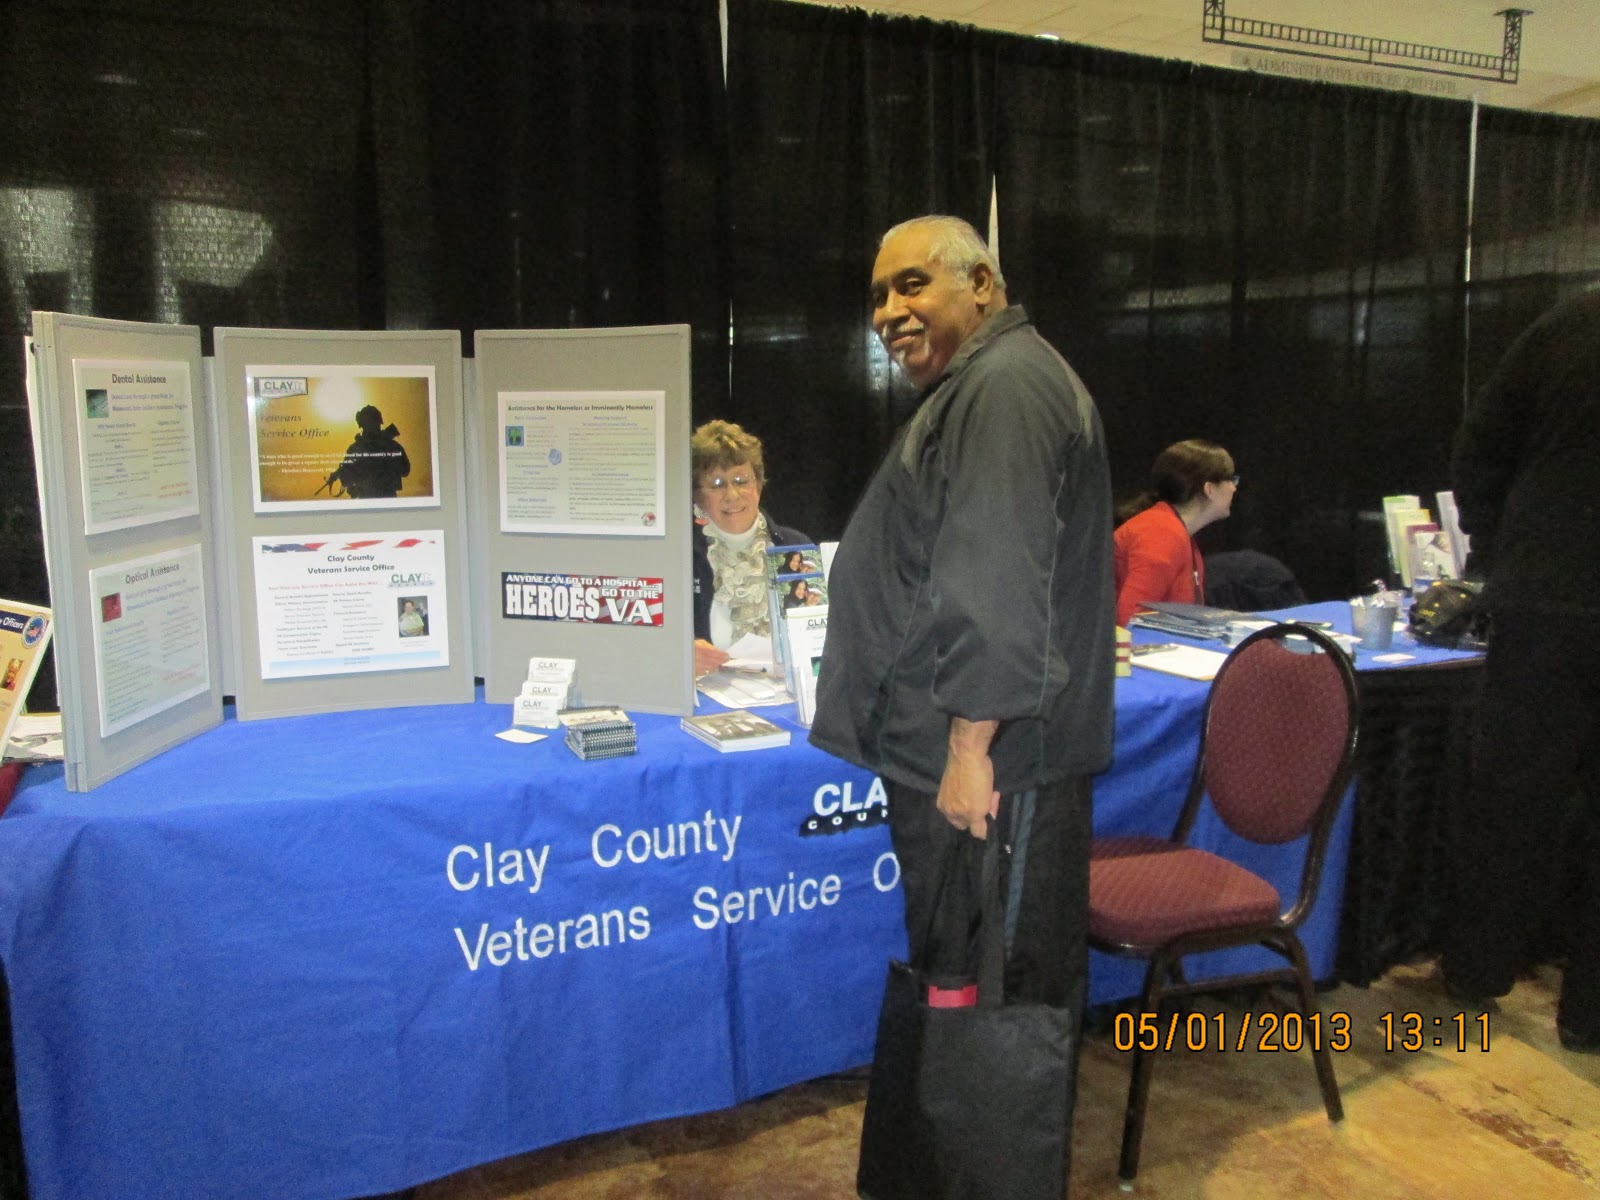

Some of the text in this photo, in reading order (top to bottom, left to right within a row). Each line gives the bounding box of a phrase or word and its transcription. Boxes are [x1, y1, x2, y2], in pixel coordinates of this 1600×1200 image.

[112, 373, 167, 384] Dental Assistance
[264, 381, 293, 390] CLAY
[299, 427, 330, 440] Office
[327, 554, 375, 563] Clay County
[125, 563, 180, 585] Optical Assistance
[307, 566, 342, 575] Veterans
[344, 564, 370, 573] Service
[391, 573, 422, 584] CLAY
[506, 574, 659, 589] ANYONE CAN GO TO A HOSPITAL...
[601, 588, 659, 599] GO TO THE
[505, 583, 600, 619] HEROES
[605, 598, 653, 624] VA
[3, 617, 24, 629] Officers
[538, 661, 558, 669] CLAY
[532, 686, 552, 694] CLAY
[523, 700, 542, 708] CLAY
[814, 777, 888, 817] CLA
[807, 808, 888, 830] COU
[446, 810, 742, 893] Clay County
[454, 852, 901, 972] Veterans Service O
